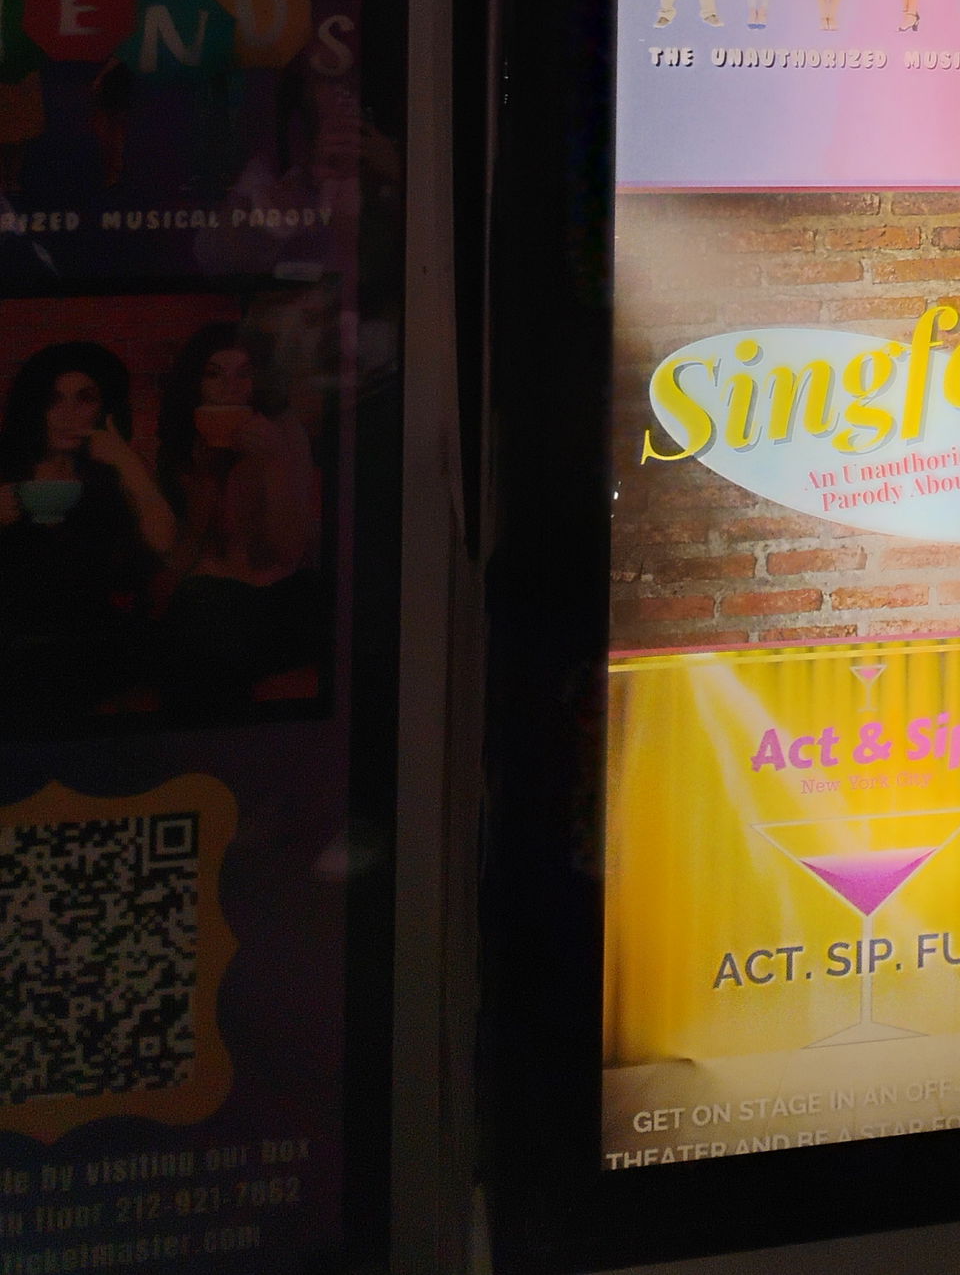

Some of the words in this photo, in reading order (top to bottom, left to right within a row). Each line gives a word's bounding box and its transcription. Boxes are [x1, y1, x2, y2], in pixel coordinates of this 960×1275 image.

[648, 47, 694, 67] THE
[711, 47, 888, 69] UNAUTHORIZED
[102, 210, 219, 230] MUSICAL
[232, 208, 332, 229] PARODY
[804, 469, 837, 492] An
[822, 482, 903, 512] Parody
[751, 726, 838, 772] Act
[853, 721, 893, 765] &
[801, 779, 840, 794] New
[849, 775, 890, 790] York
[713, 946, 813, 990] ACT.
[826, 937, 902, 978] SIP.
[633, 1107, 685, 1134] GET
[692, 1102, 731, 1126] ON
[739, 1092, 821, 1122] STAGE
[829, 1086, 855, 1111] IN
[863, 1085, 897, 1107] AN
[606, 1140, 728, 1171] THEATER
[735, 1132, 791, 1154] AND
